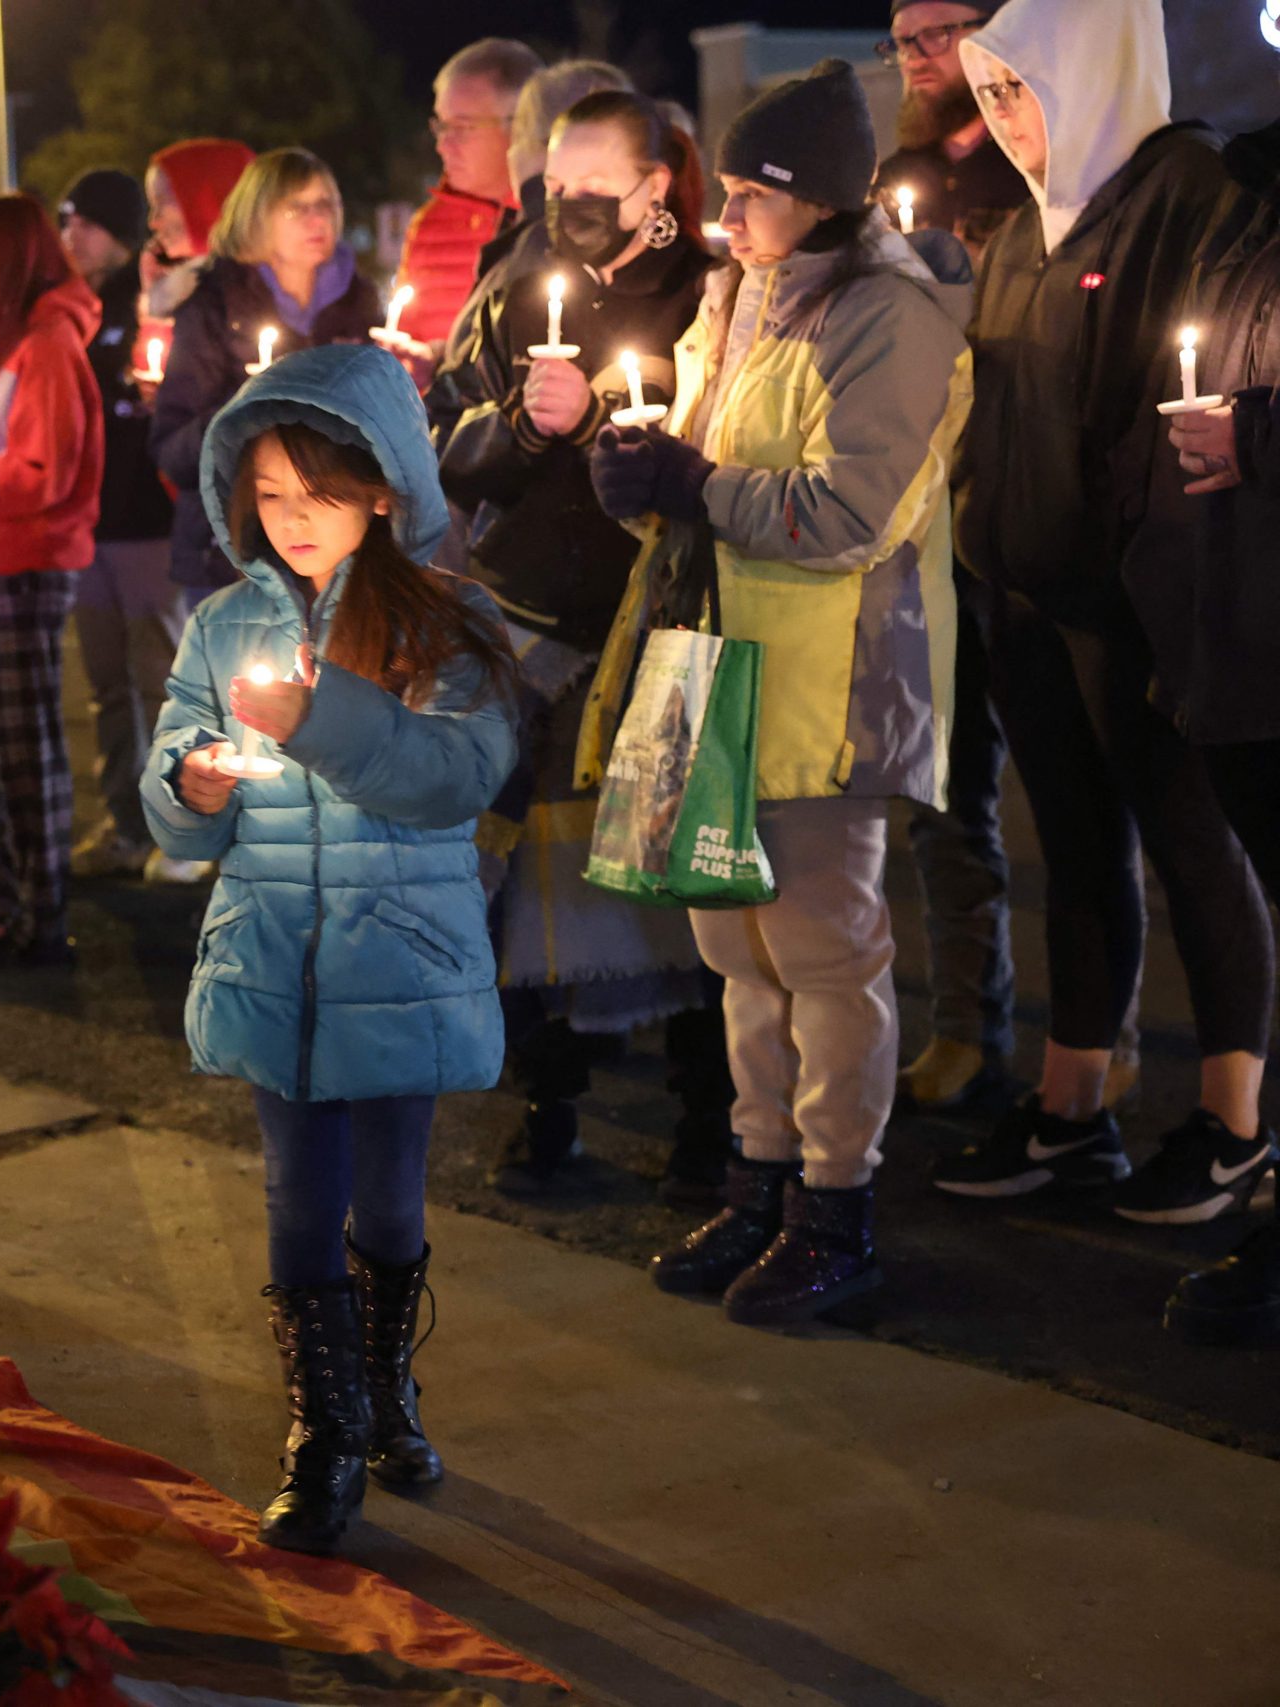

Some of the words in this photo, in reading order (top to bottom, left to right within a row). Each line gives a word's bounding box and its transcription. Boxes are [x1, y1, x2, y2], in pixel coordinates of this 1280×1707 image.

[697, 825, 729, 845] PET
[694, 840, 759, 864] SUPPLIE
[690, 857, 732, 879] PLUS
